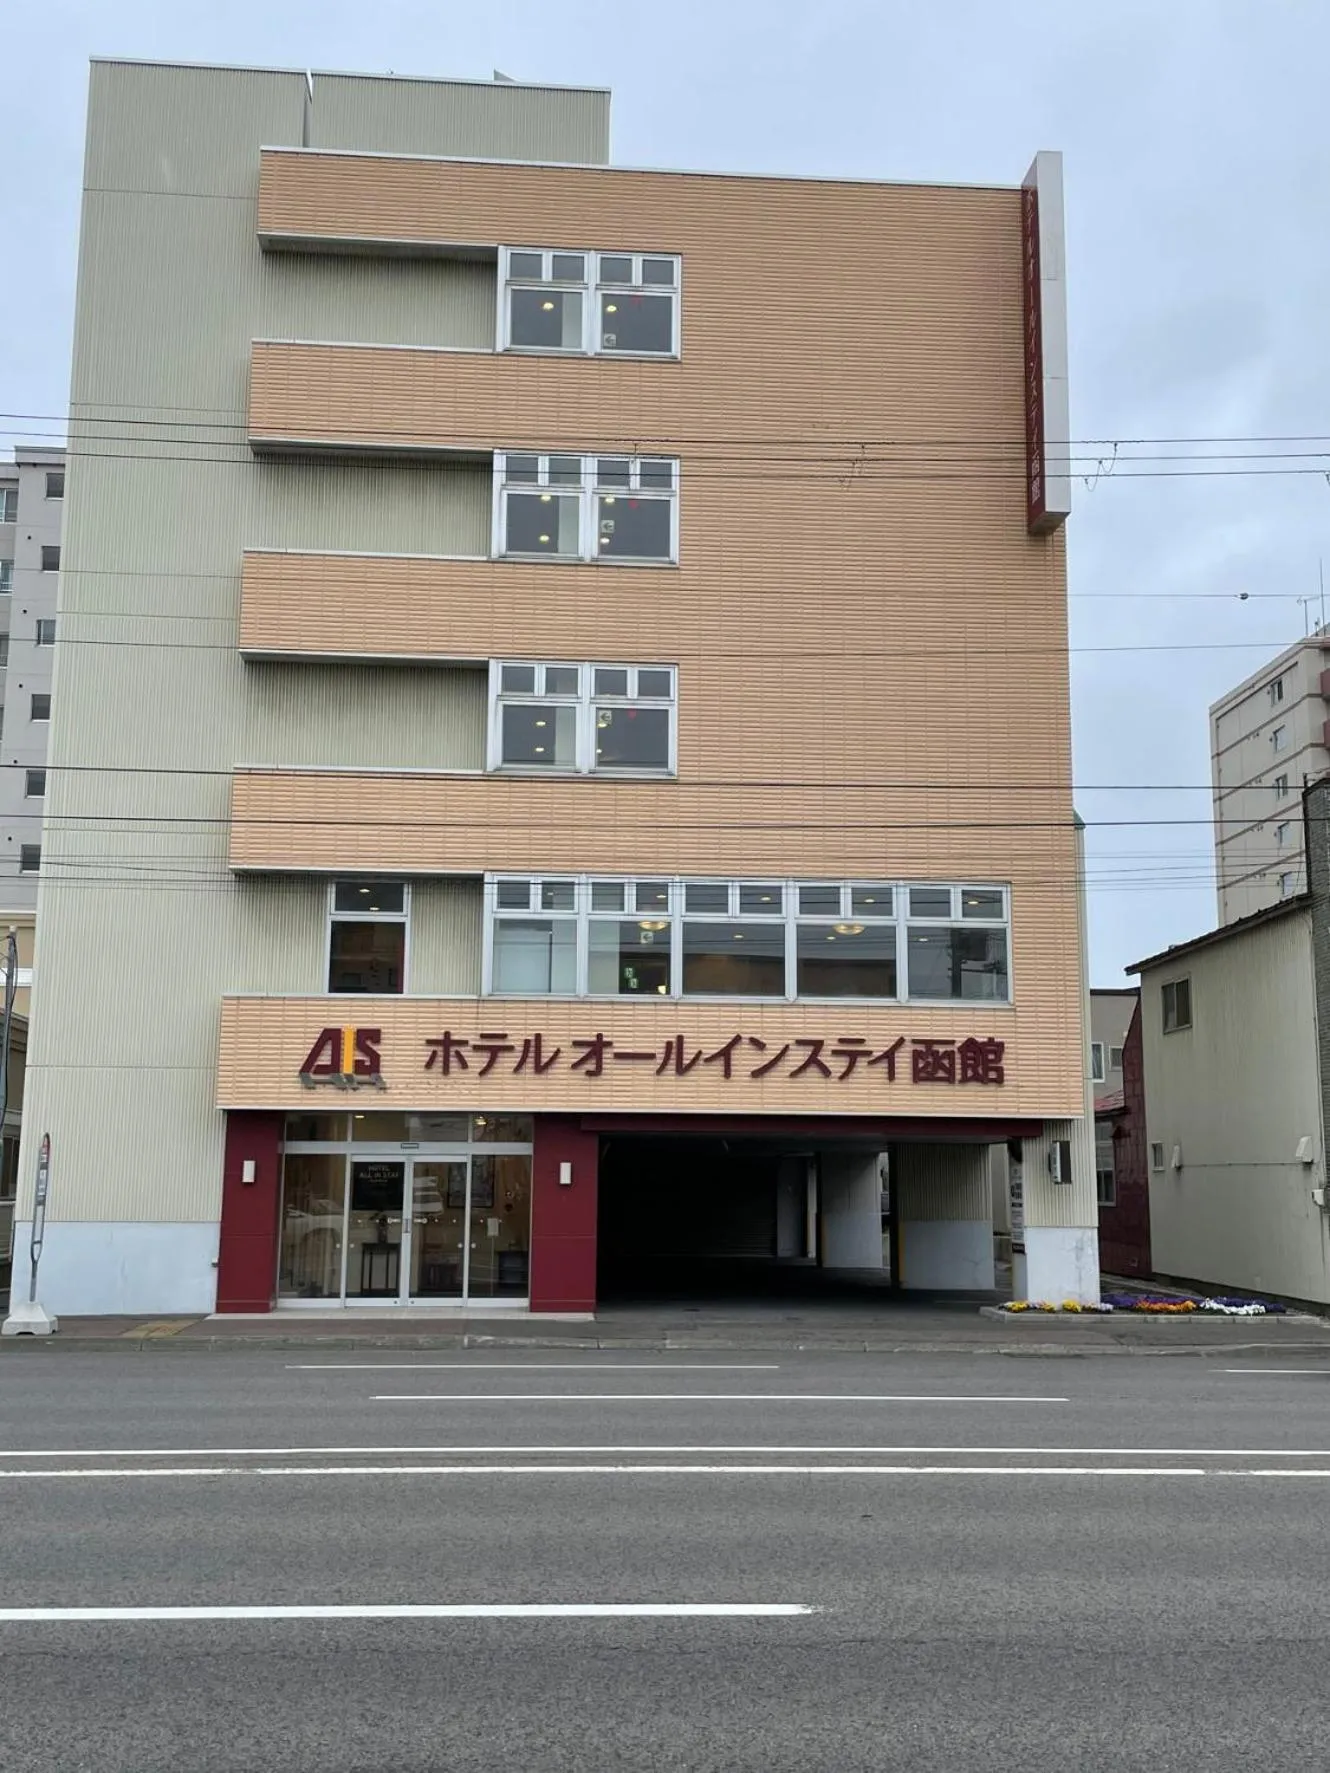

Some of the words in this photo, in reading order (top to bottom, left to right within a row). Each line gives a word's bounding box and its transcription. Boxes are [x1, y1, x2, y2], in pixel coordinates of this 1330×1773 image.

[424, 1030, 1005, 1085] ホテルオールインステイ函館
